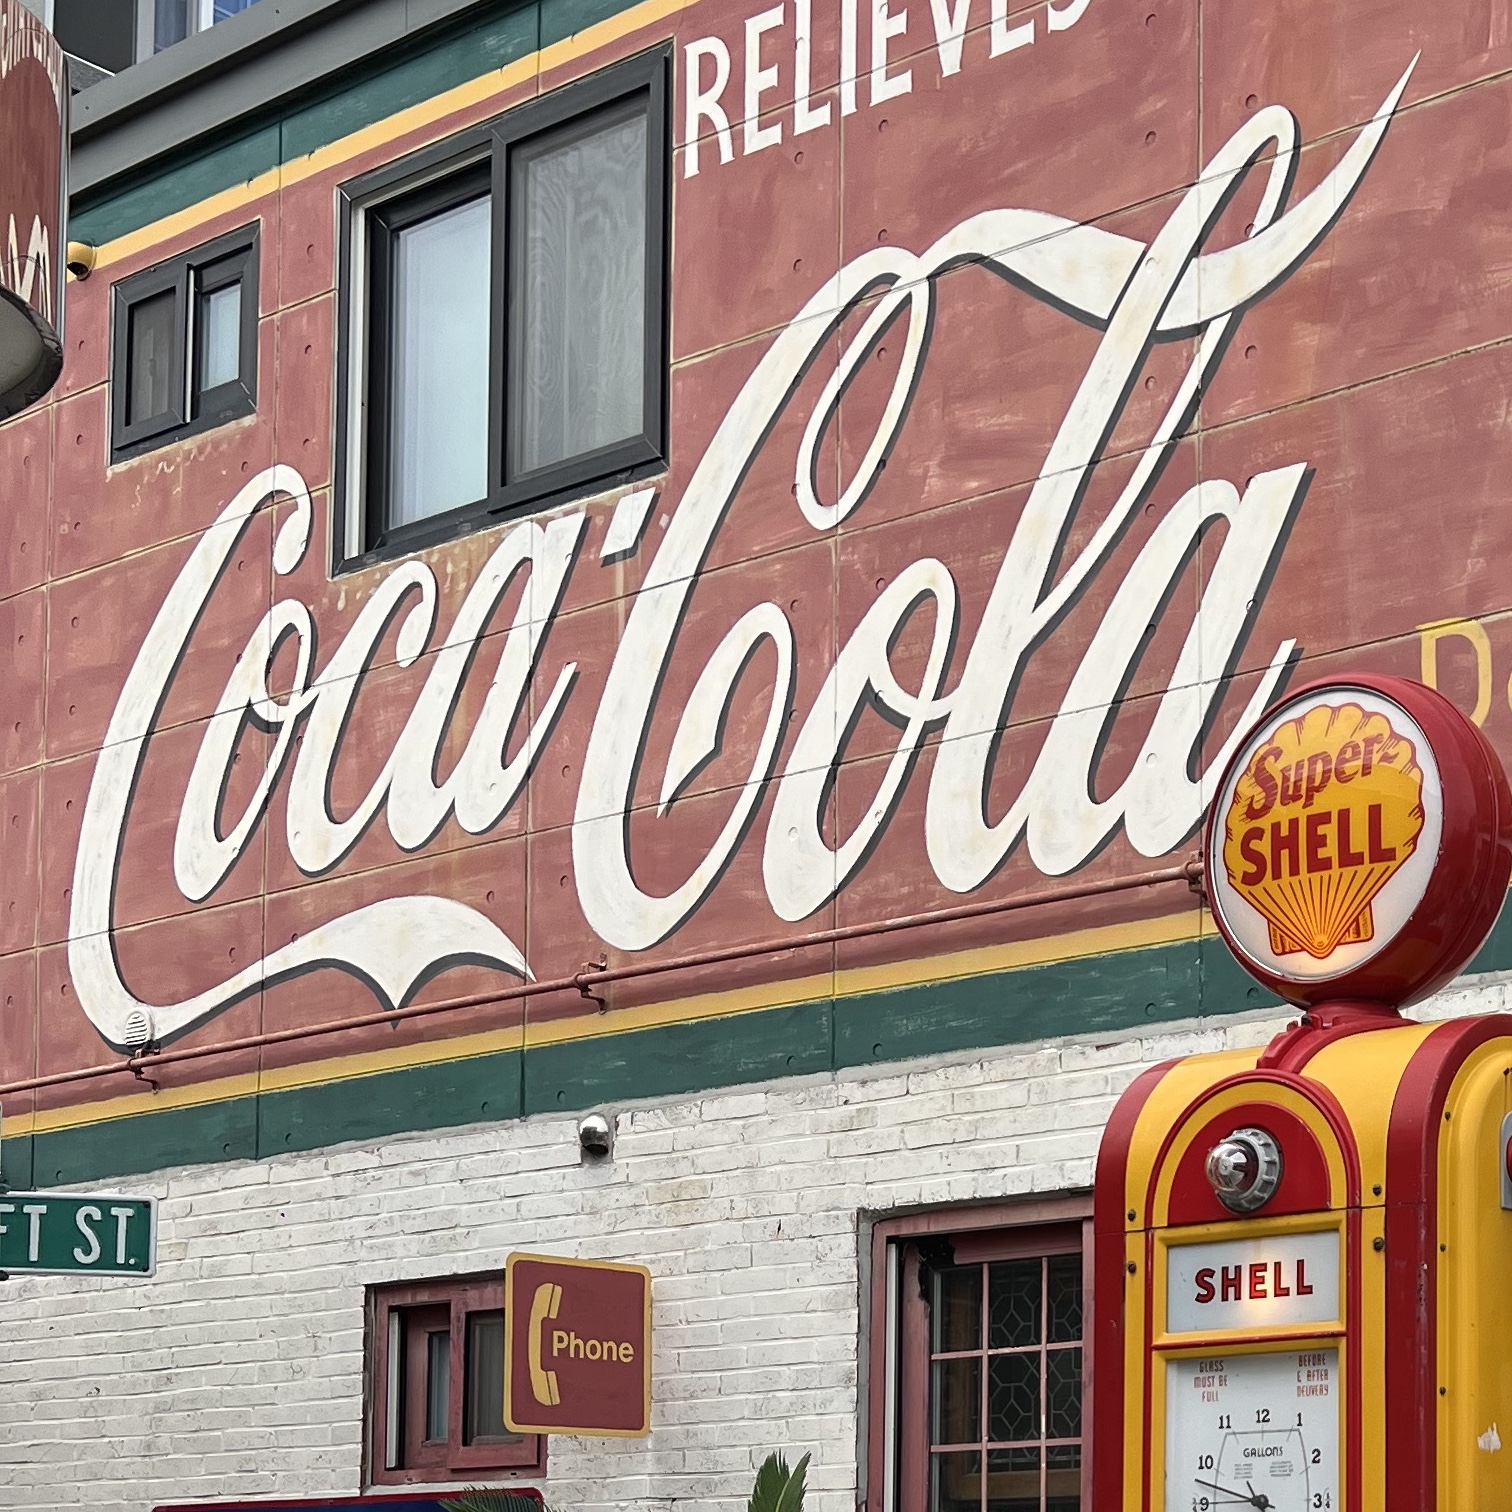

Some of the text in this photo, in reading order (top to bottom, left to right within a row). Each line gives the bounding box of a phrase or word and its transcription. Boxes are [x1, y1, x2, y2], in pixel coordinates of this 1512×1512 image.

[70, 52, 1422, 1047] Coca-Cola
[1240, 803, 1397, 886] SHELL
[73, 1205, 136, 1265] ST.
[1195, 1258, 1313, 1304] SHELL
[552, 1331, 634, 1363] Phone
[1199, 1360, 1224, 1373] GLASS
[1298, 1353, 1326, 1367] BEFORE
[1194, 1375, 1216, 1388] MUST
[1306, 1368, 1329, 1382] AFTER
[1218, 1414, 1232, 1429] 11
[1255, 1408, 1271, 1423] 12
[1296, 1412, 1303, 1427] 1
[1243, 1446, 1284, 1458] GALLONS
[1311, 1448, 1321, 1464] 2
[1198, 1454, 1214, 1470] 10
[1199, 1497, 1209, 1512] 9
[1313, 1493, 1323, 1509] 3
